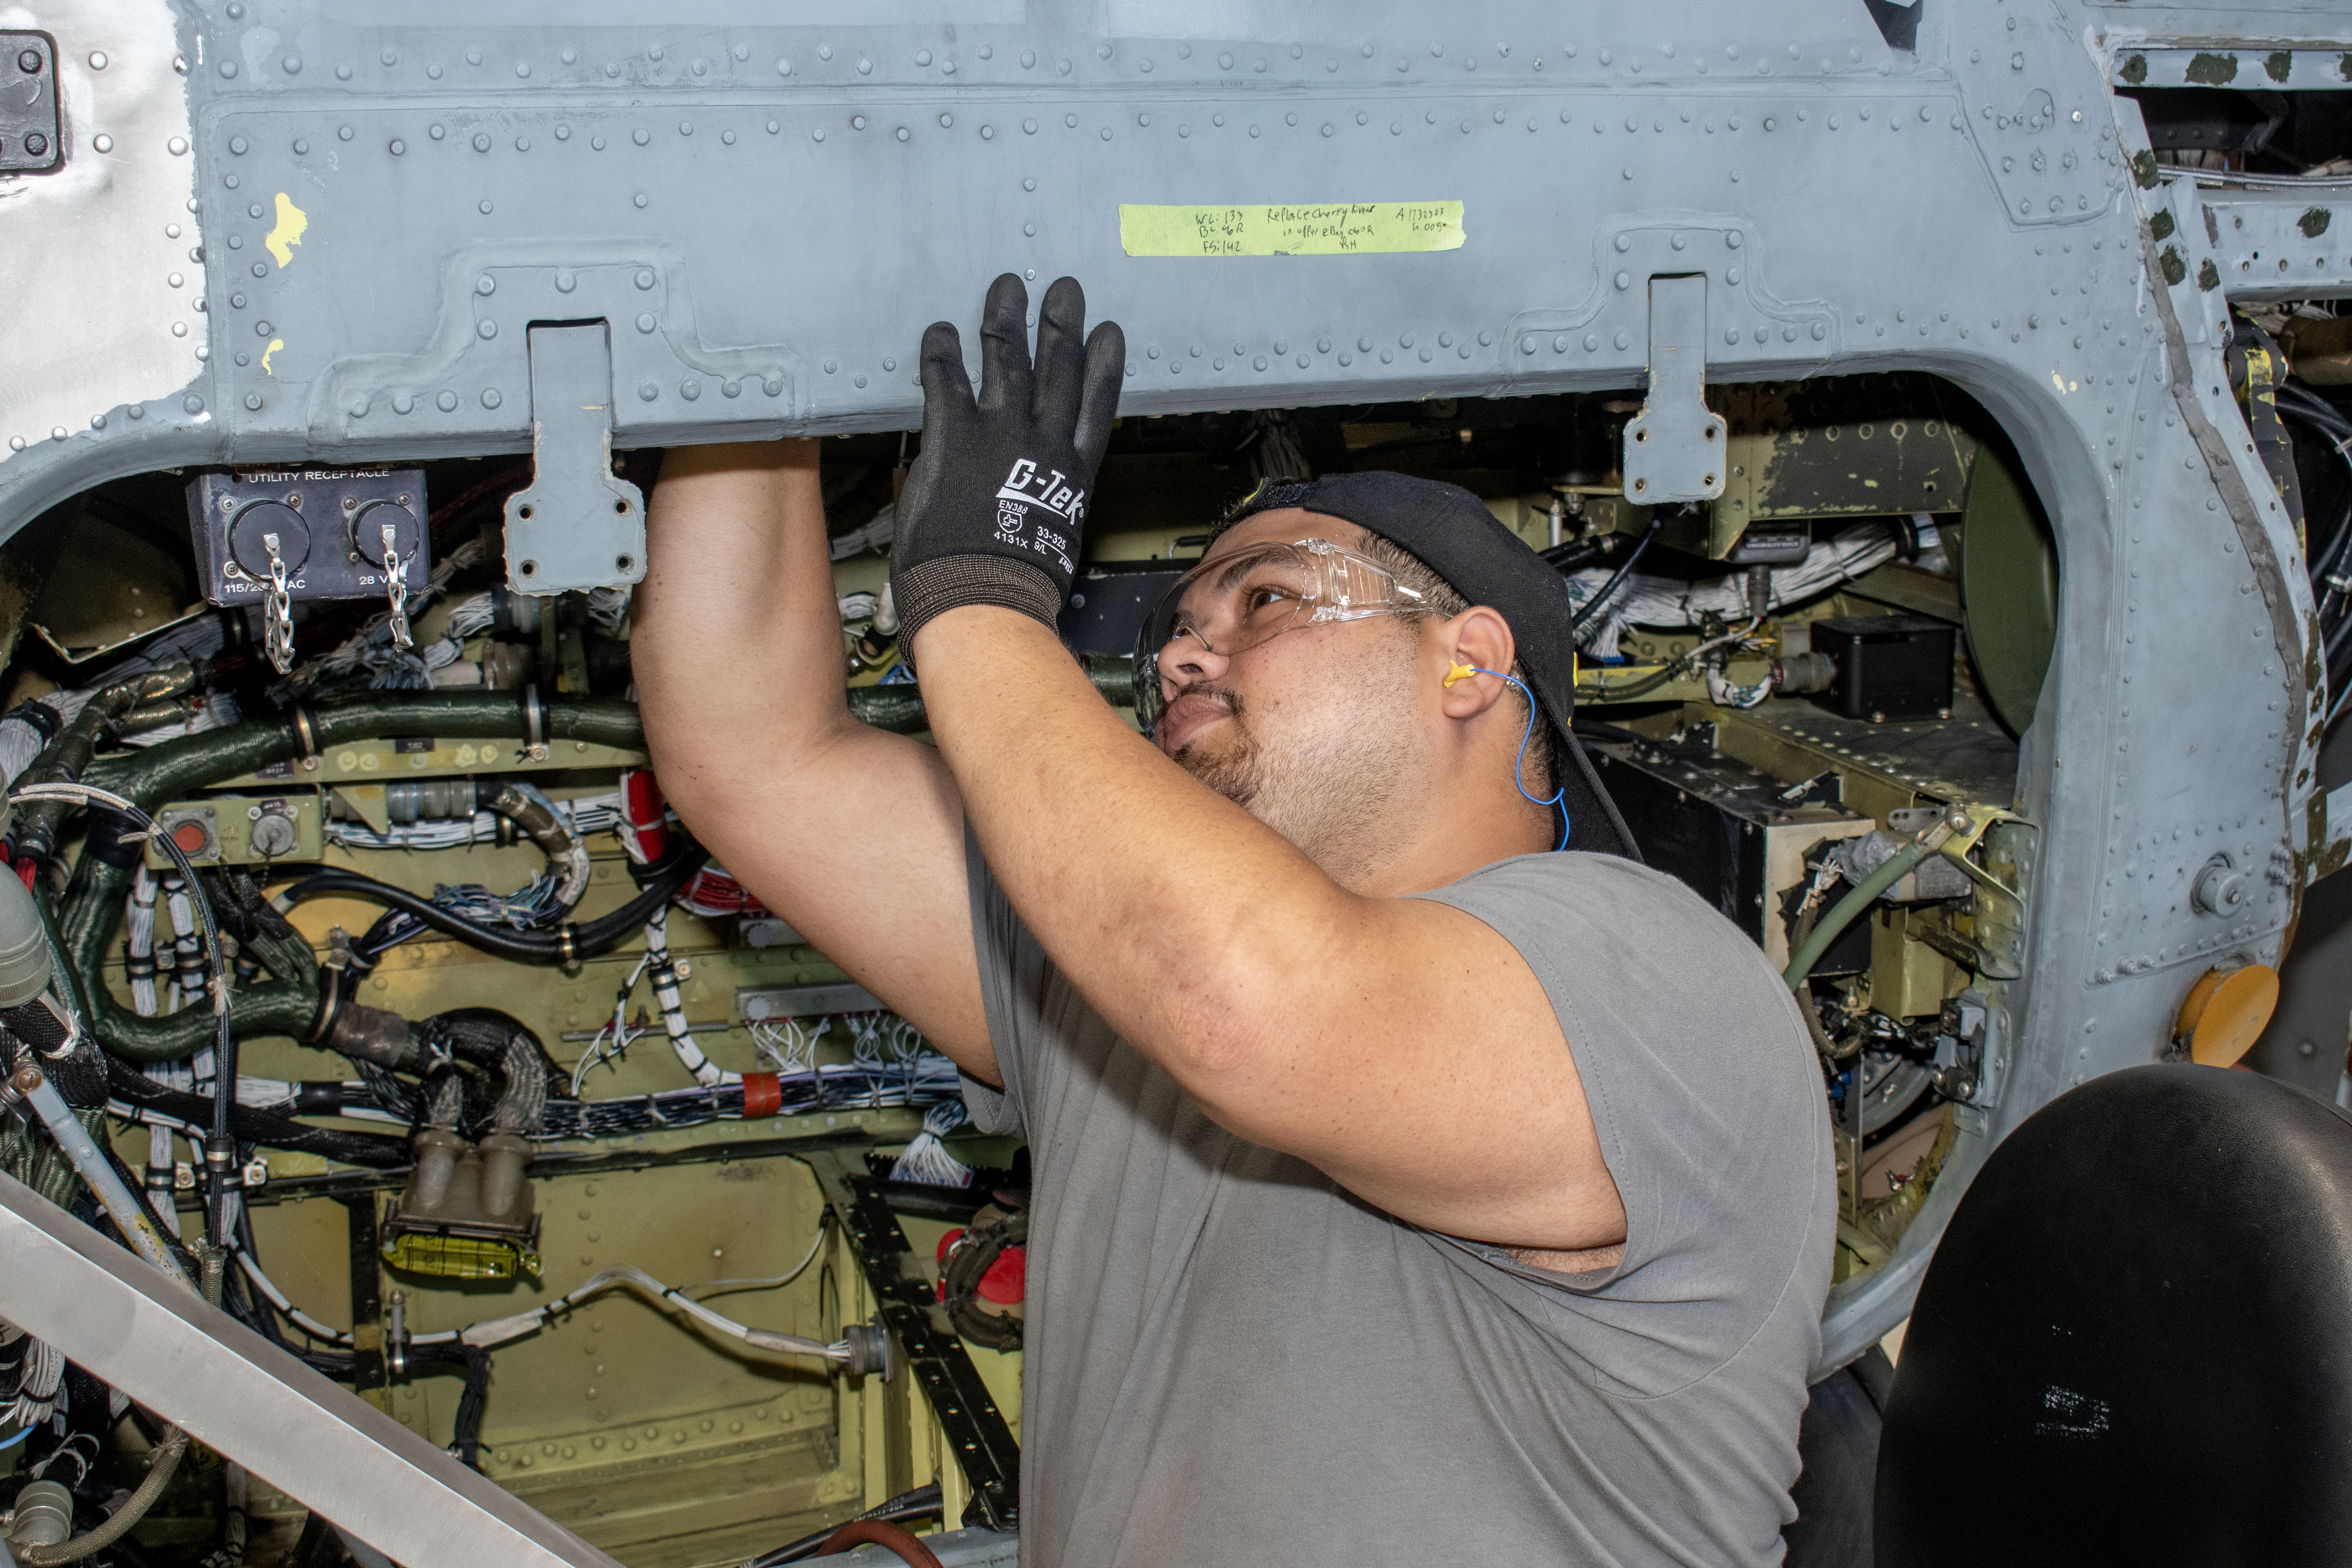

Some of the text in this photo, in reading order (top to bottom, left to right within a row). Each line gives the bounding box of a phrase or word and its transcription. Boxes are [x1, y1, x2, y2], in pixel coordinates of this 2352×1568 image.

[248, 469, 390, 483] UTILITY RECEPTACLE
[999, 500, 1028, 514] EN388
[994, 531, 1029, 549] 4131X
[1037, 526, 1067, 550] 33-325
[359, 576, 375, 585] 28
